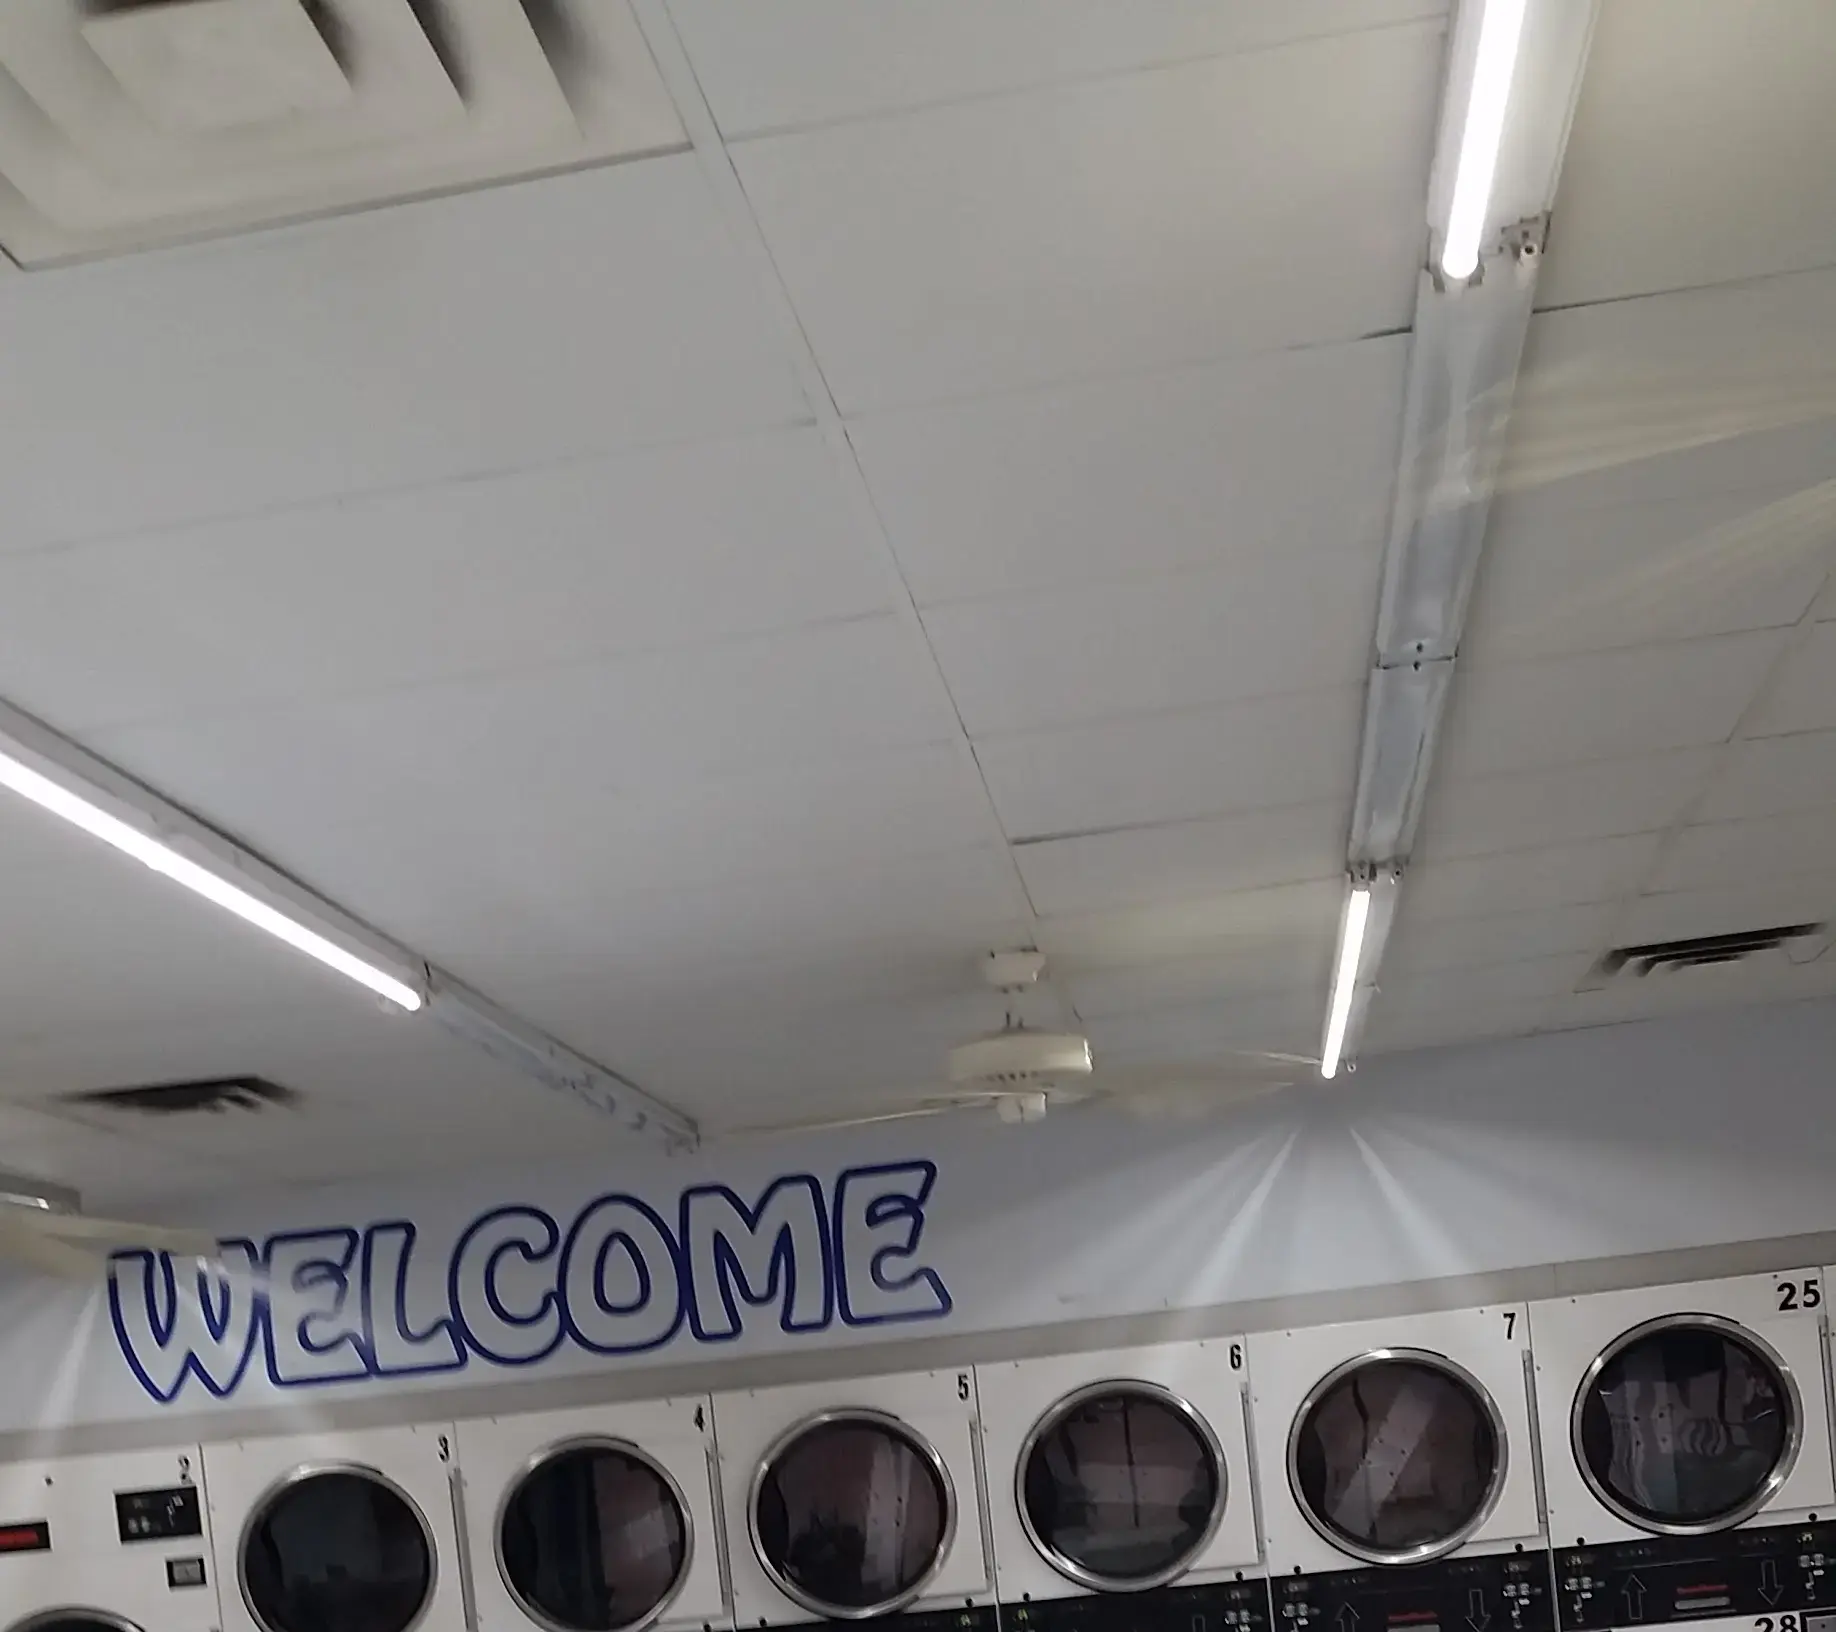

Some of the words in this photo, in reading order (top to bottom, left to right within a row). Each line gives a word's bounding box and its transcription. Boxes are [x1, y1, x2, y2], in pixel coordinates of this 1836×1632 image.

[107, 1160, 953, 1402] WELCOME
[1777, 1279, 1821, 1311] 25
[1503, 1312, 1516, 1340] 7
[1230, 1344, 1242, 1370] 6
[958, 1374, 969, 1401] 5
[695, 1404, 706, 1432] 4
[438, 1434, 450, 1463] 3
